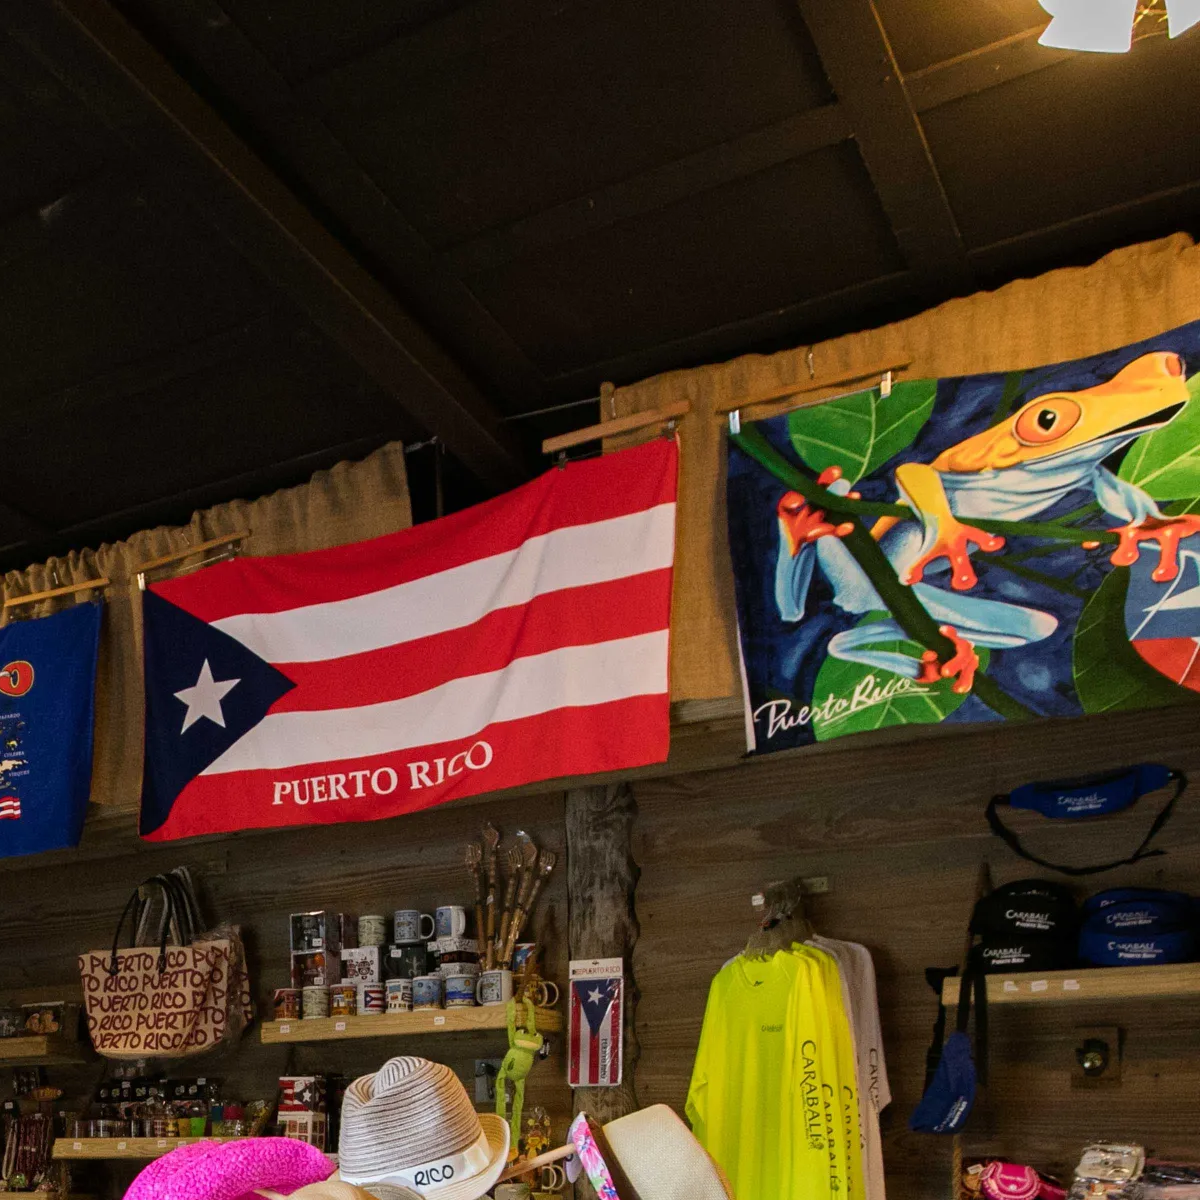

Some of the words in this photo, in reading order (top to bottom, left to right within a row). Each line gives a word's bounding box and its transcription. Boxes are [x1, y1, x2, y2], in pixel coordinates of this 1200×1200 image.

[753, 691, 852, 739] Puerto
[848, 674, 918, 711] Rico
[272, 766, 398, 805] PUERTO
[407, 740, 494, 790] RICO
[90, 953, 154, 975] PUERTO
[103, 974, 140, 993] RICO
[142, 968, 205, 992] PUERTO
[88, 993, 150, 1014] PUERTO
[150, 990, 187, 1010] RICO
[100, 1013, 133, 1031] RICO
[93, 1031, 141, 1050] UERTO
[143, 1031, 182, 1050] RICO
[801, 1039, 823, 1141] CARABALÍ
[414, 1164, 455, 1187] RICO
